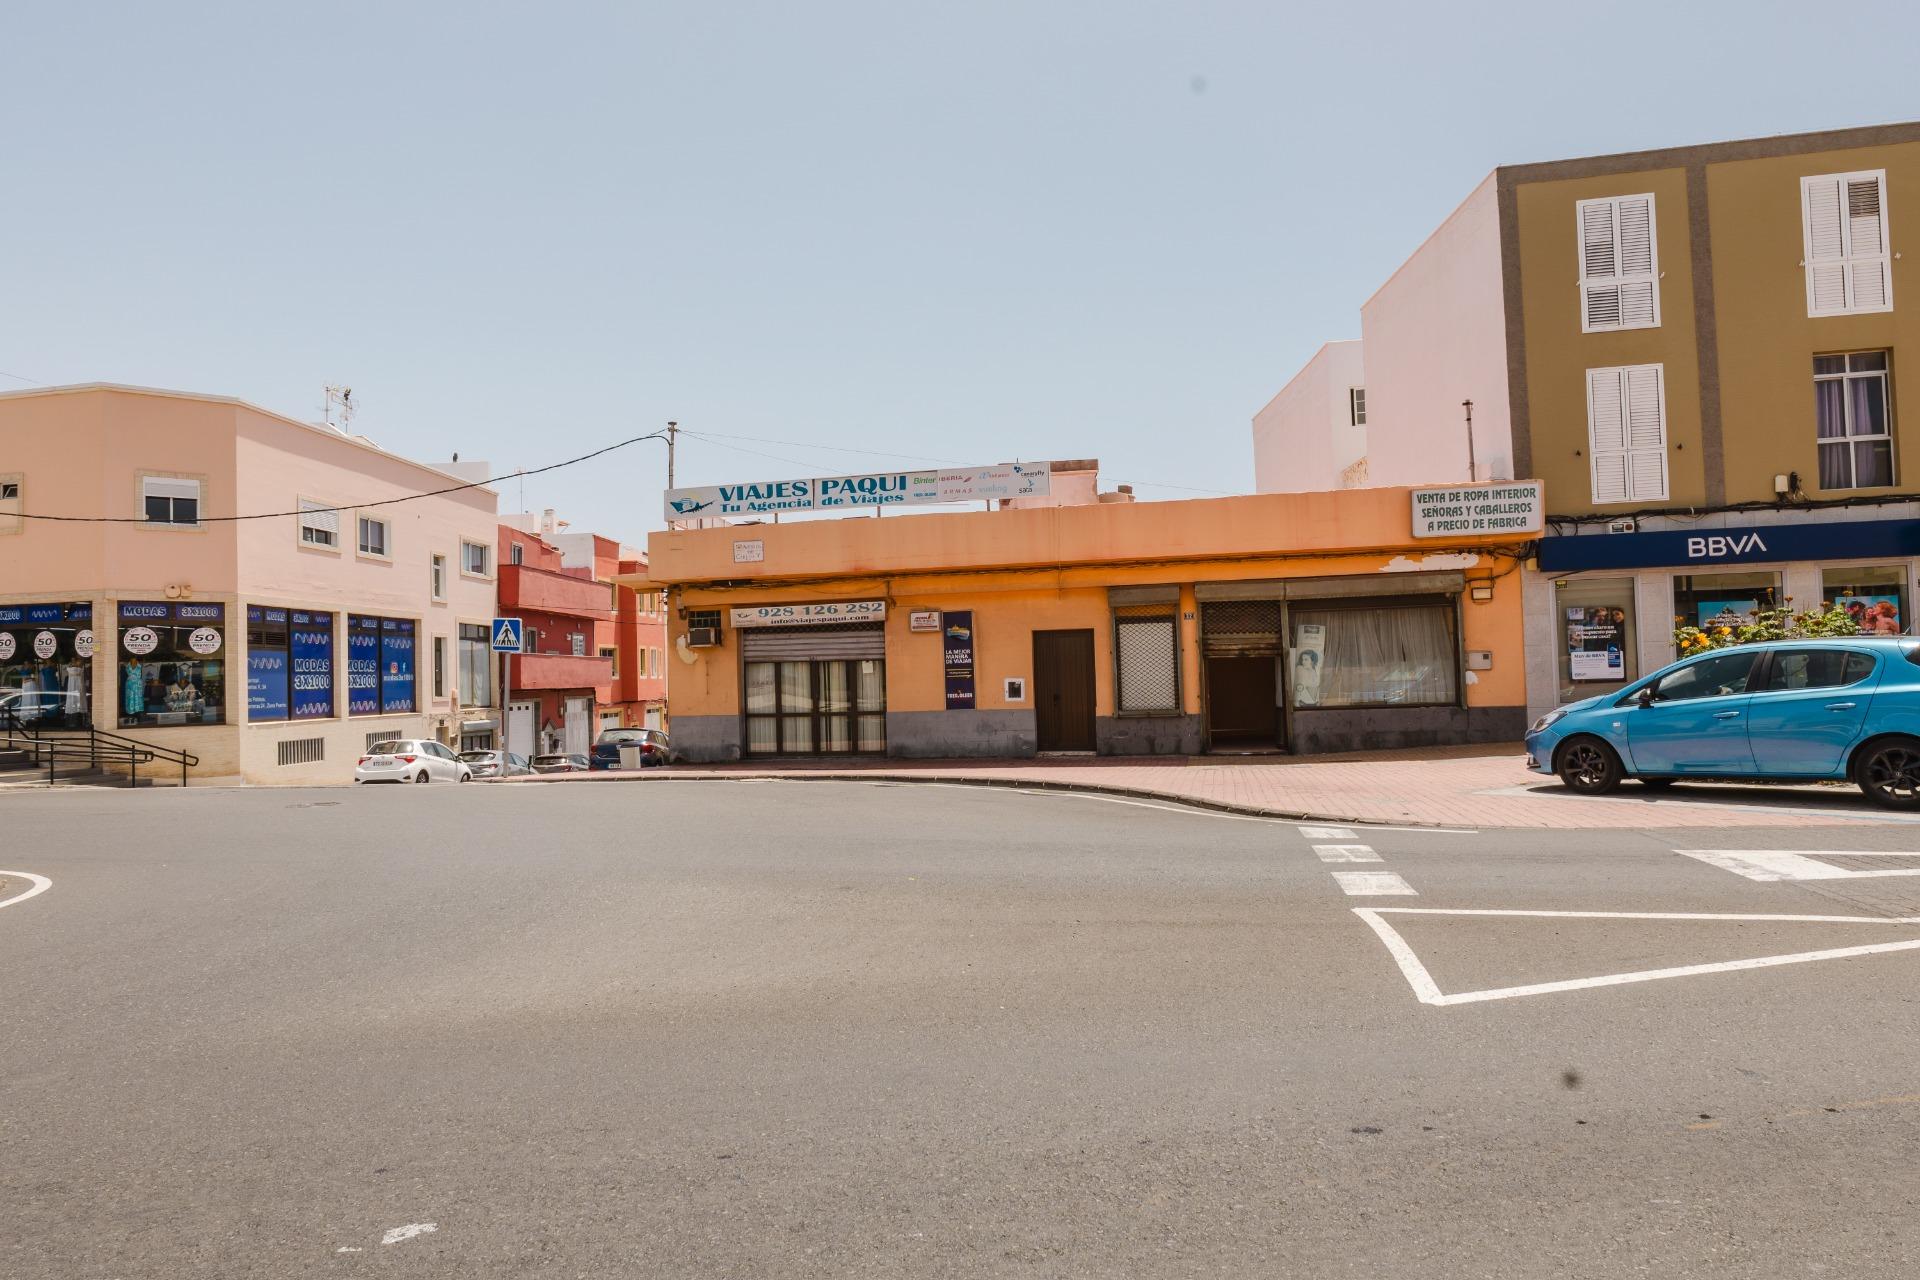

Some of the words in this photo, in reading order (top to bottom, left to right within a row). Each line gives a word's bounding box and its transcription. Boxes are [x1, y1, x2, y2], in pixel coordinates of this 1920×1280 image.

[914, 477, 936, 485] Binter
[719, 481, 808, 501] VIAJES
[822, 475, 906, 495] PAQUI
[1417, 492, 1446, 504] VENTA
[1449, 491, 1461, 502] DE
[1464, 490, 1489, 502] ROPA
[1492, 487, 1537, 500] INTERIOR
[720, 503, 741, 512] Tu
[747, 498, 812, 512] Agencia
[822, 496, 844, 506] de
[850, 494, 904, 505] Viajes
[1422, 505, 1463, 518] SEÑORAS
[1466, 505, 1472, 516] Y
[1474, 503, 1532, 516] CABALLEROS
[1428, 521, 1434, 532] A
[1437, 520, 1470, 531] PRECIO
[1473, 518, 1485, 529] DE
[1488, 516, 1527, 529] FABRICA
[1687, 532, 1768, 558] BBVA
[123, 605, 167, 617] MODAS
[181, 606, 219, 617] 3X1000
[758, 607, 794, 617] 928
[803, 604, 838, 616] 126
[846, 602, 883, 613] 282
[771, 615, 870, 625] info@viajespaqui.com
[38, 638, 53, 646] 50
[79, 636, 93, 645] 50
[129, 633, 152, 642] 50
[194, 633, 215, 642] 50
[295, 659, 330, 672] MODAS
[295, 675, 331, 689] 3X1000
